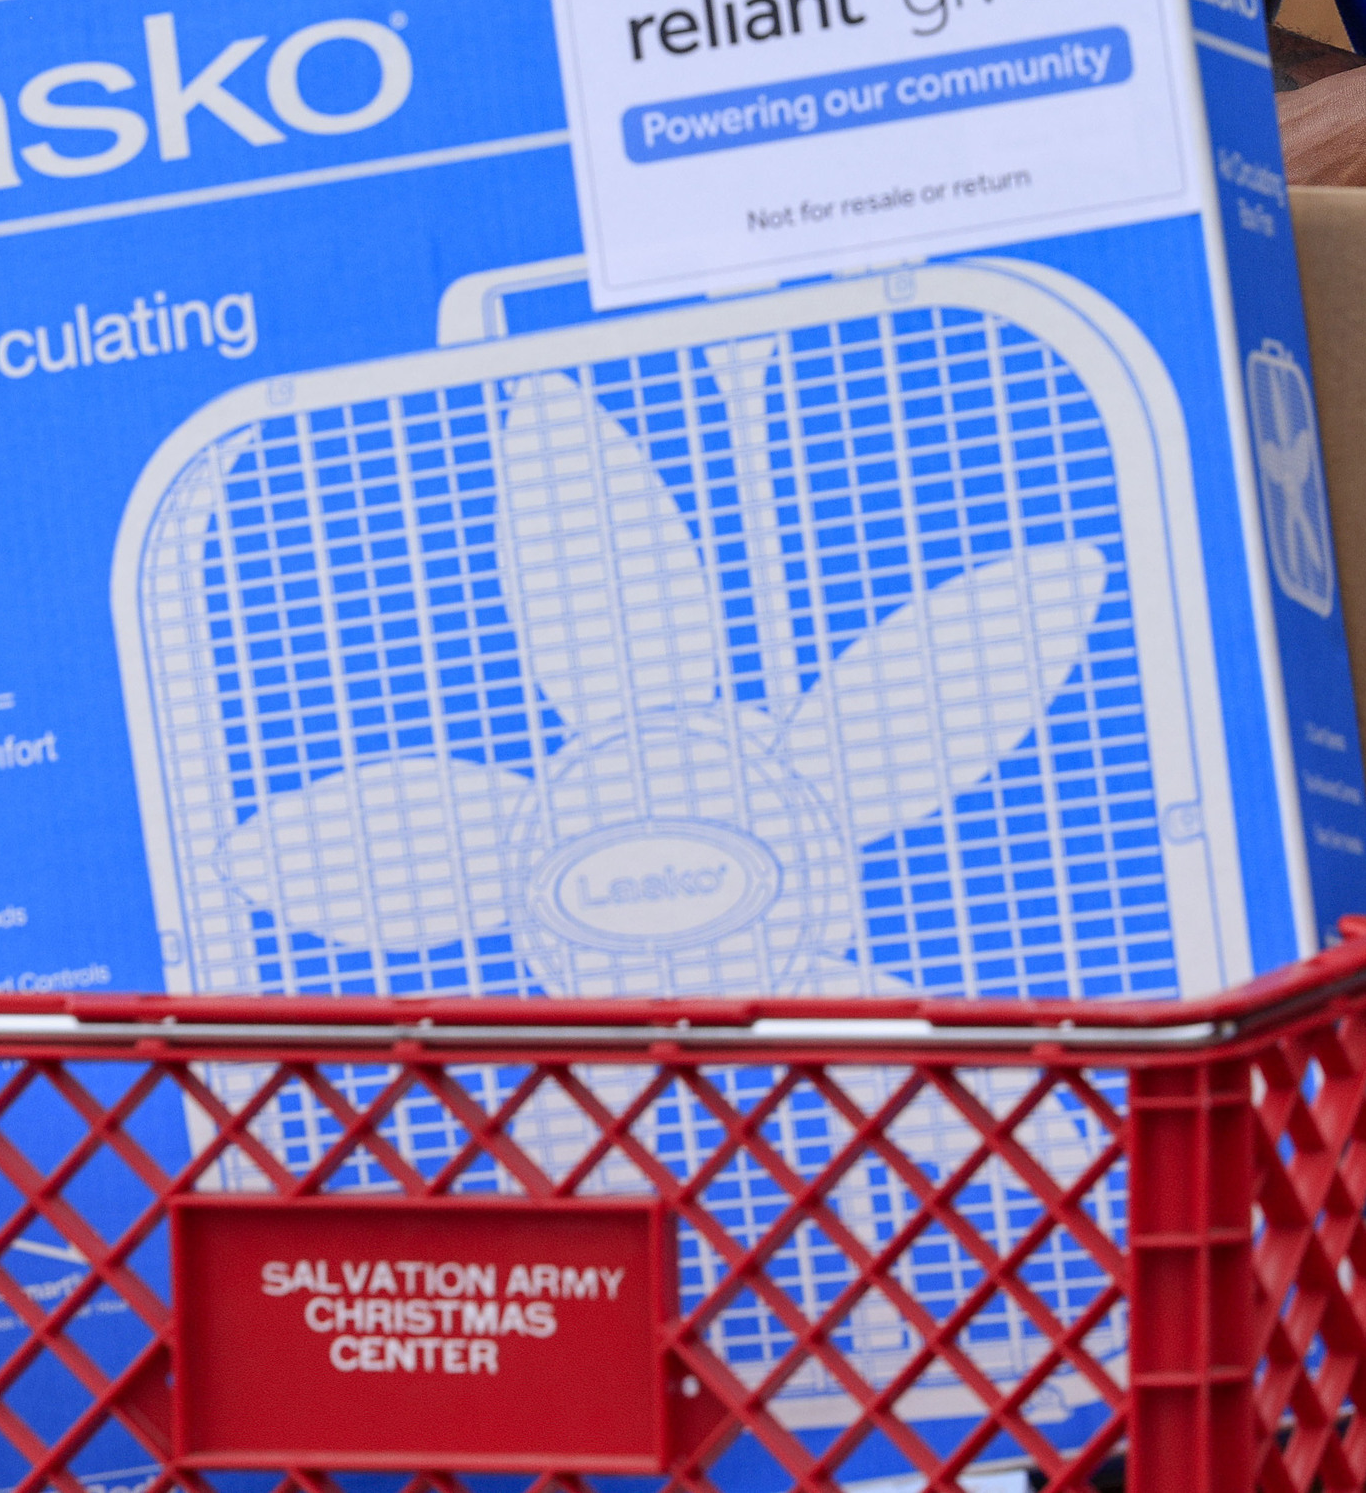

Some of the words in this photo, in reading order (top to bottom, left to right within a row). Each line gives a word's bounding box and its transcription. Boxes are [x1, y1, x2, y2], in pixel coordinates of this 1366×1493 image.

[641, 93, 819, 148] Powering
[824, 84, 890, 119] our
[896, 43, 1112, 106] community
[747, 205, 795, 233] Not
[799, 199, 835, 224] for
[840, 187, 915, 220] resale
[919, 182, 947, 205] or
[952, 168, 1032, 199] return
[575, 864, 722, 907] Lasko
[17, 964, 111, 993] Controls
[261, 1259, 497, 1297] SALVATION
[505, 1263, 625, 1300] ARMY
[305, 1296, 558, 1338] CHRISTMAS
[329, 1335, 500, 1374] CENTER
